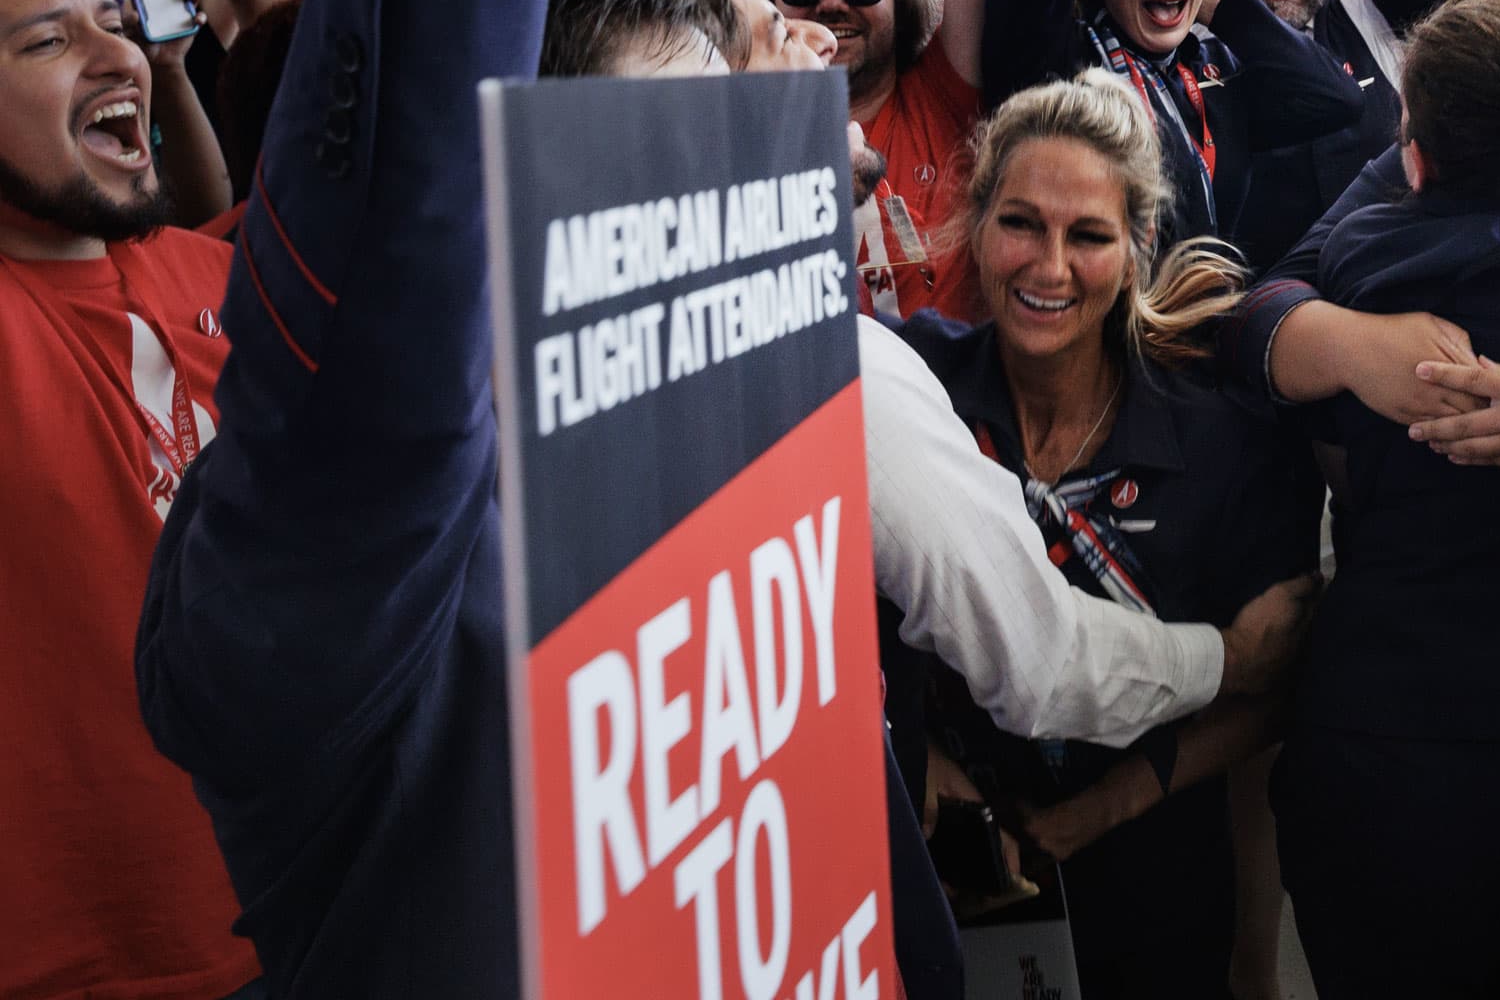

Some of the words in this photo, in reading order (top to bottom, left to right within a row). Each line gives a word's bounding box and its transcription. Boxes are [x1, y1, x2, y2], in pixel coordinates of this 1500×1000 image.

[542, 188, 721, 316] AMERICAN
[726, 166, 837, 264] AIRLINES
[178, 411, 191, 432] ARE
[536, 313, 664, 436] FLIGHT
[669, 251, 847, 382] ATTENDANTS:
[567, 495, 840, 937] READY
[674, 778, 790, 1000] TO
